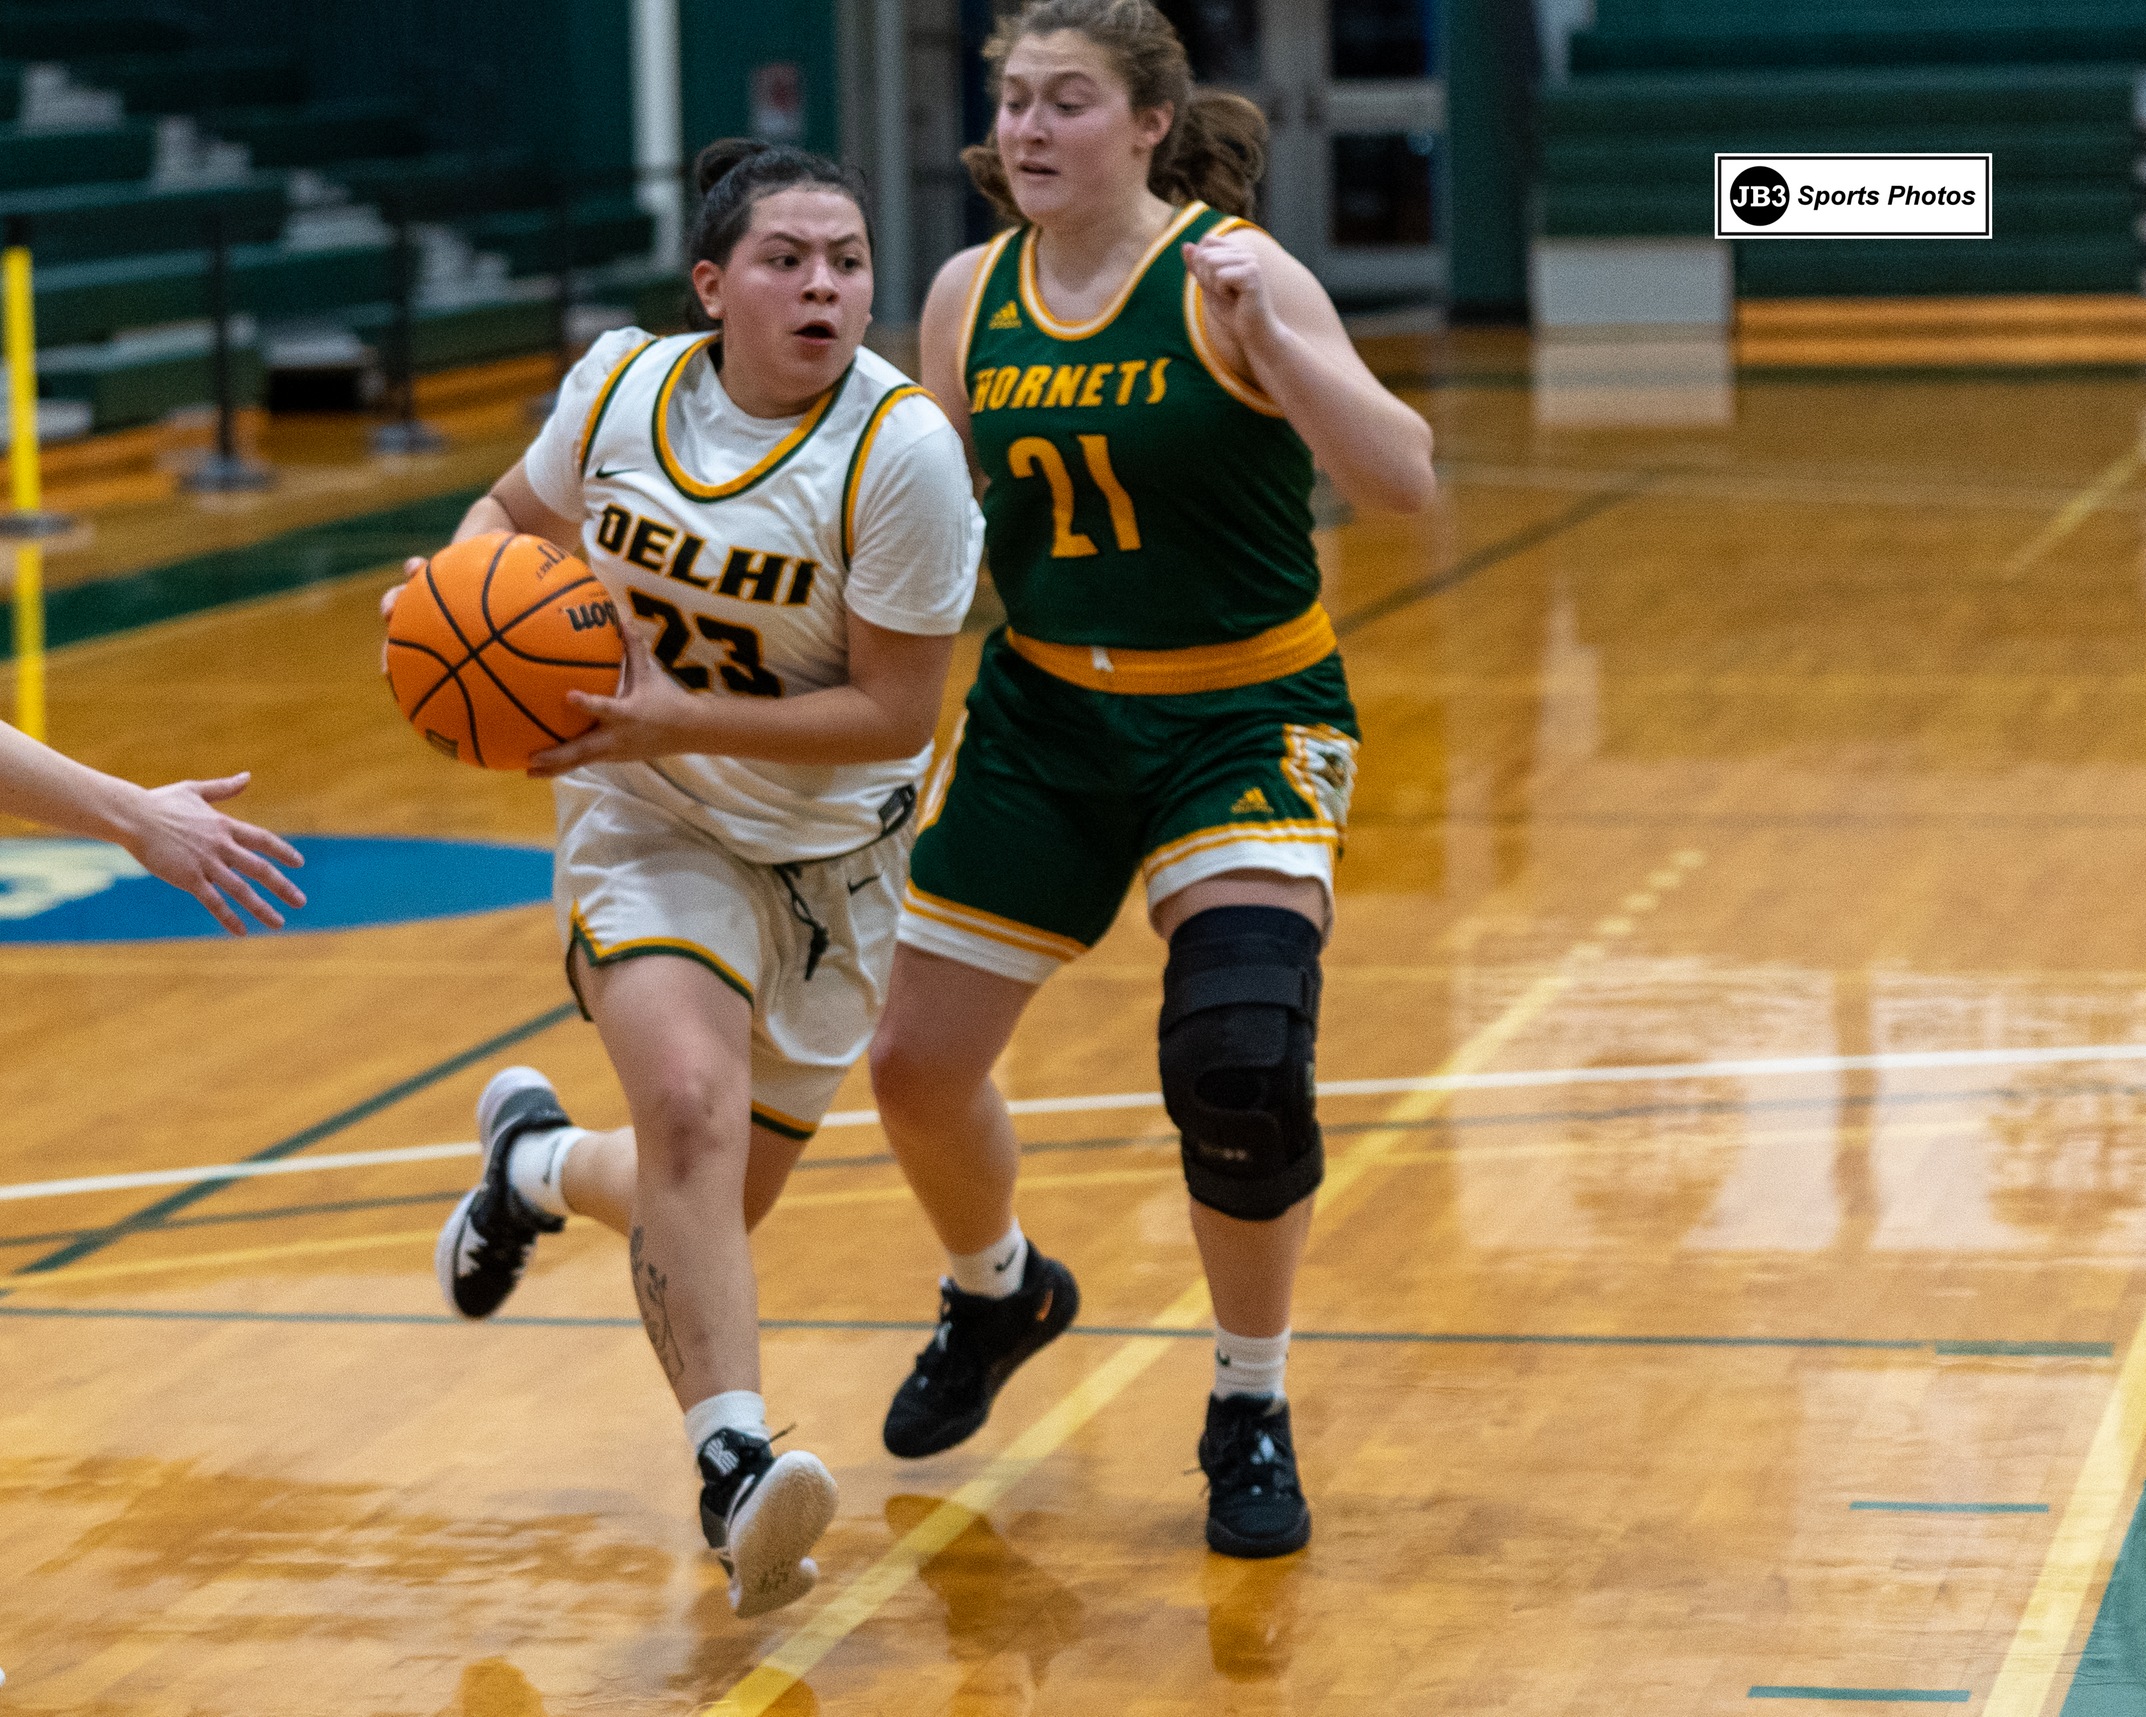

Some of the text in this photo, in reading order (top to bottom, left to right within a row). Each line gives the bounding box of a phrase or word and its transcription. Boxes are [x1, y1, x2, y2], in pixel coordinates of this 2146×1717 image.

[971, 357, 1172, 414] HORNETS
[1007, 434, 1142, 558] 21
[597, 503, 821, 606] DELHI
[629, 588, 783, 697] 23
